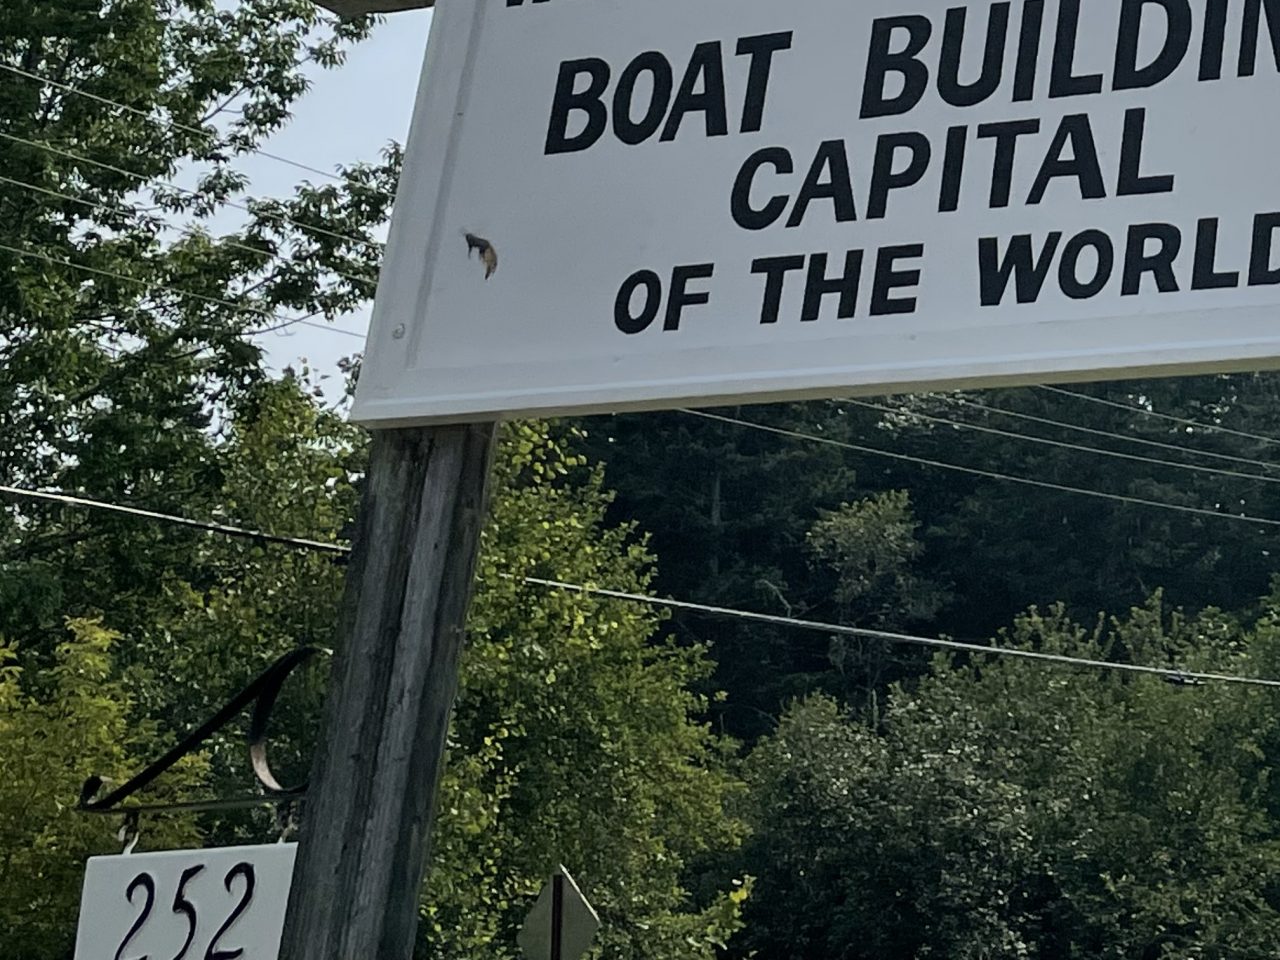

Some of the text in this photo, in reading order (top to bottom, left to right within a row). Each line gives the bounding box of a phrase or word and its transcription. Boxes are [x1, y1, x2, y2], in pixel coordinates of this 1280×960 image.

[544, 31, 794, 155] BOAT
[731, 108, 1175, 230] CAPITAL
[614, 263, 715, 334] OF
[751, 244, 924, 325] THE
[114, 862, 256, 960] 252
